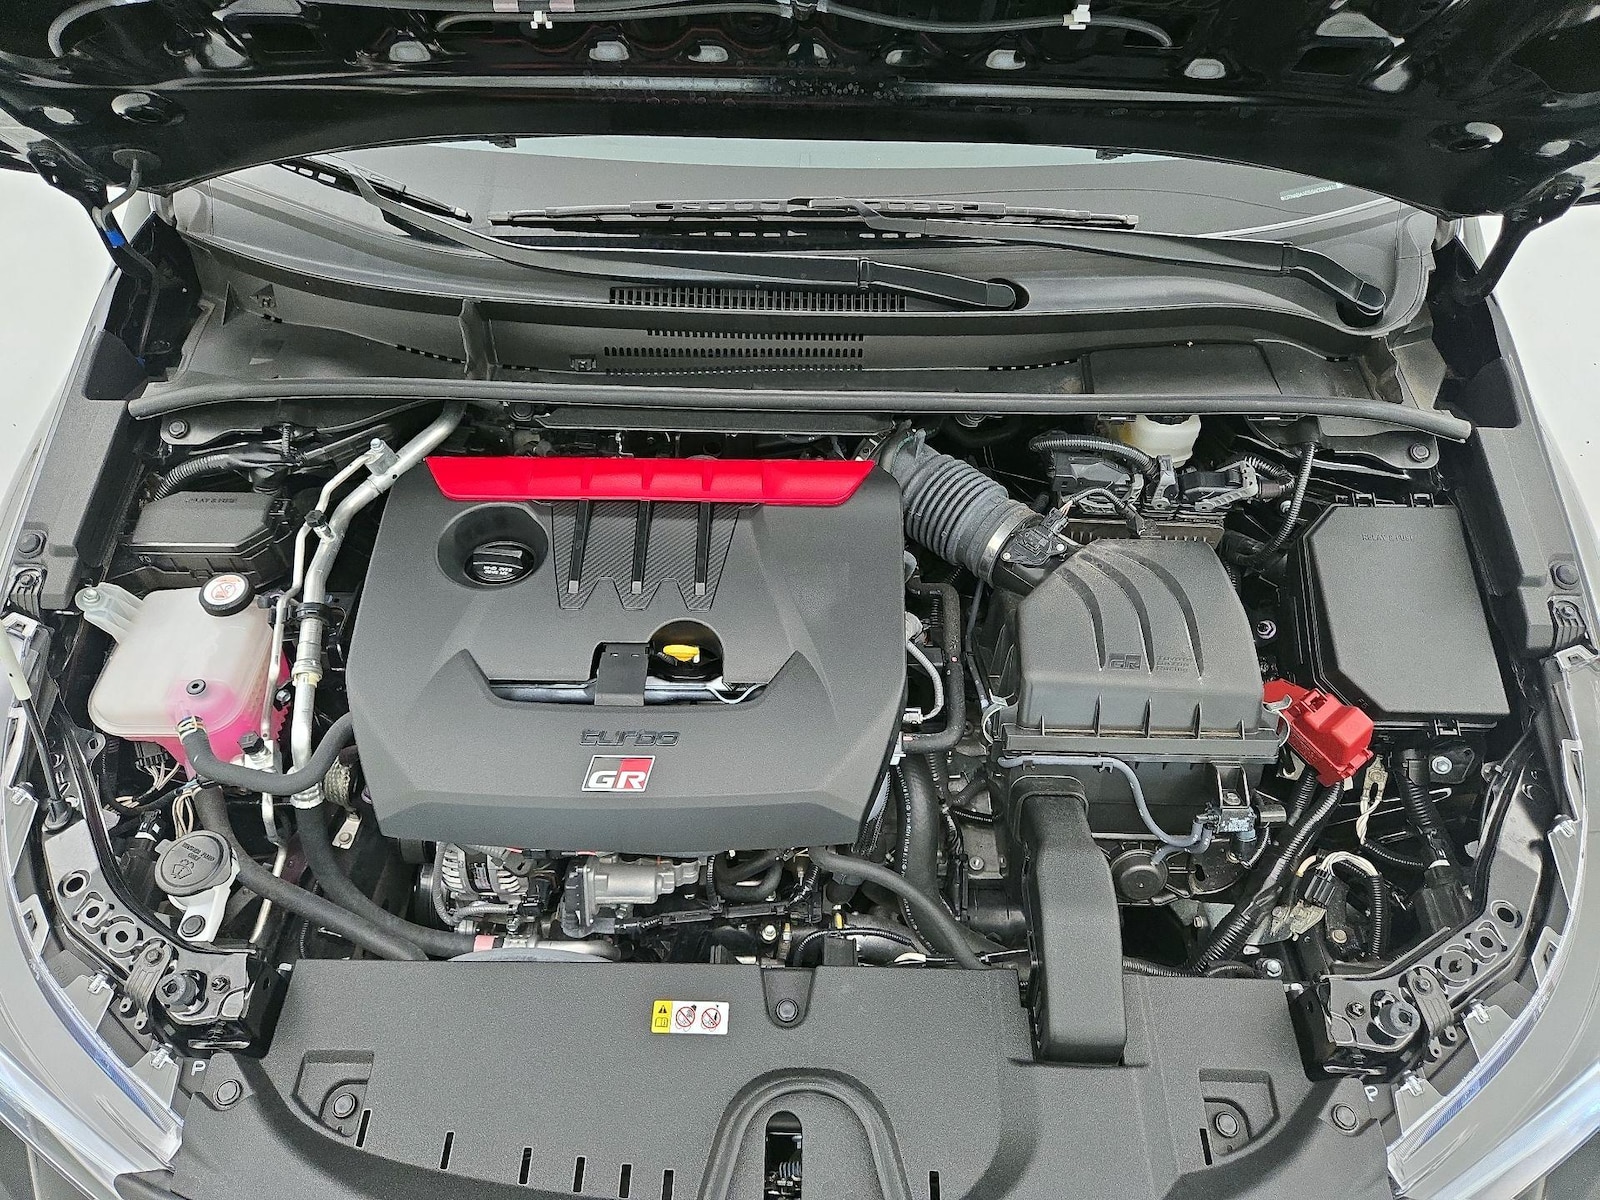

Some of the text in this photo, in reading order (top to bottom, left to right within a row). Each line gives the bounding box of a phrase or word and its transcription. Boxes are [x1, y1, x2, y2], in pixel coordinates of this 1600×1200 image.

[588, 770, 648, 790] GR
[191, 1060, 206, 1076] P
[1364, 1085, 1379, 1102] P
